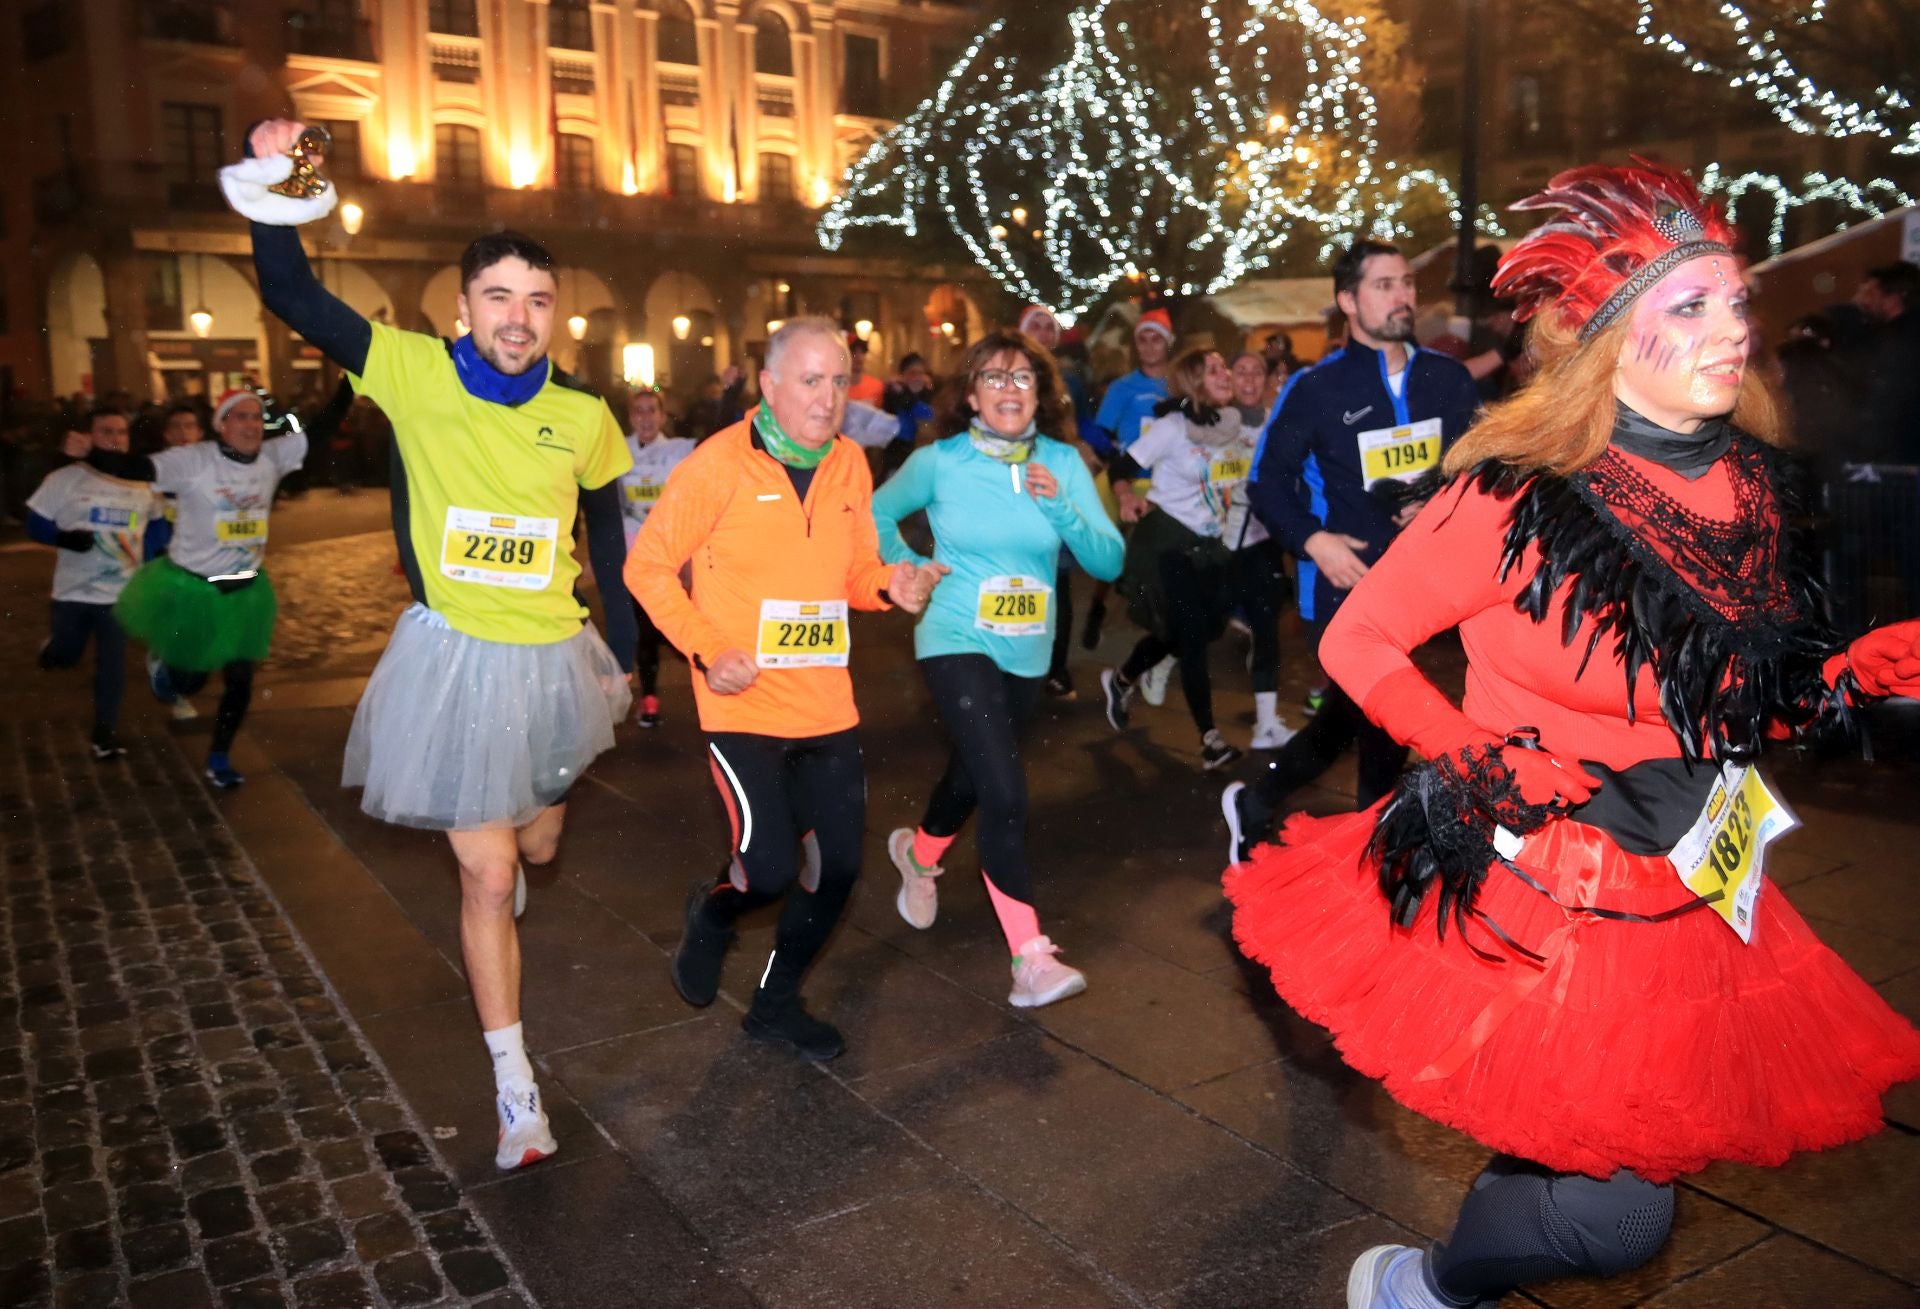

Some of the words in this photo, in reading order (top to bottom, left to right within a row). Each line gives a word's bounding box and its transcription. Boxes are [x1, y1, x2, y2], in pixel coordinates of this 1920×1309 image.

[1383, 442, 1428, 468] 1794
[464, 534, 535, 565] 2289
[994, 594, 1036, 616] 2286
[778, 623, 834, 647] 2284
[1710, 790, 1752, 886] 1823
